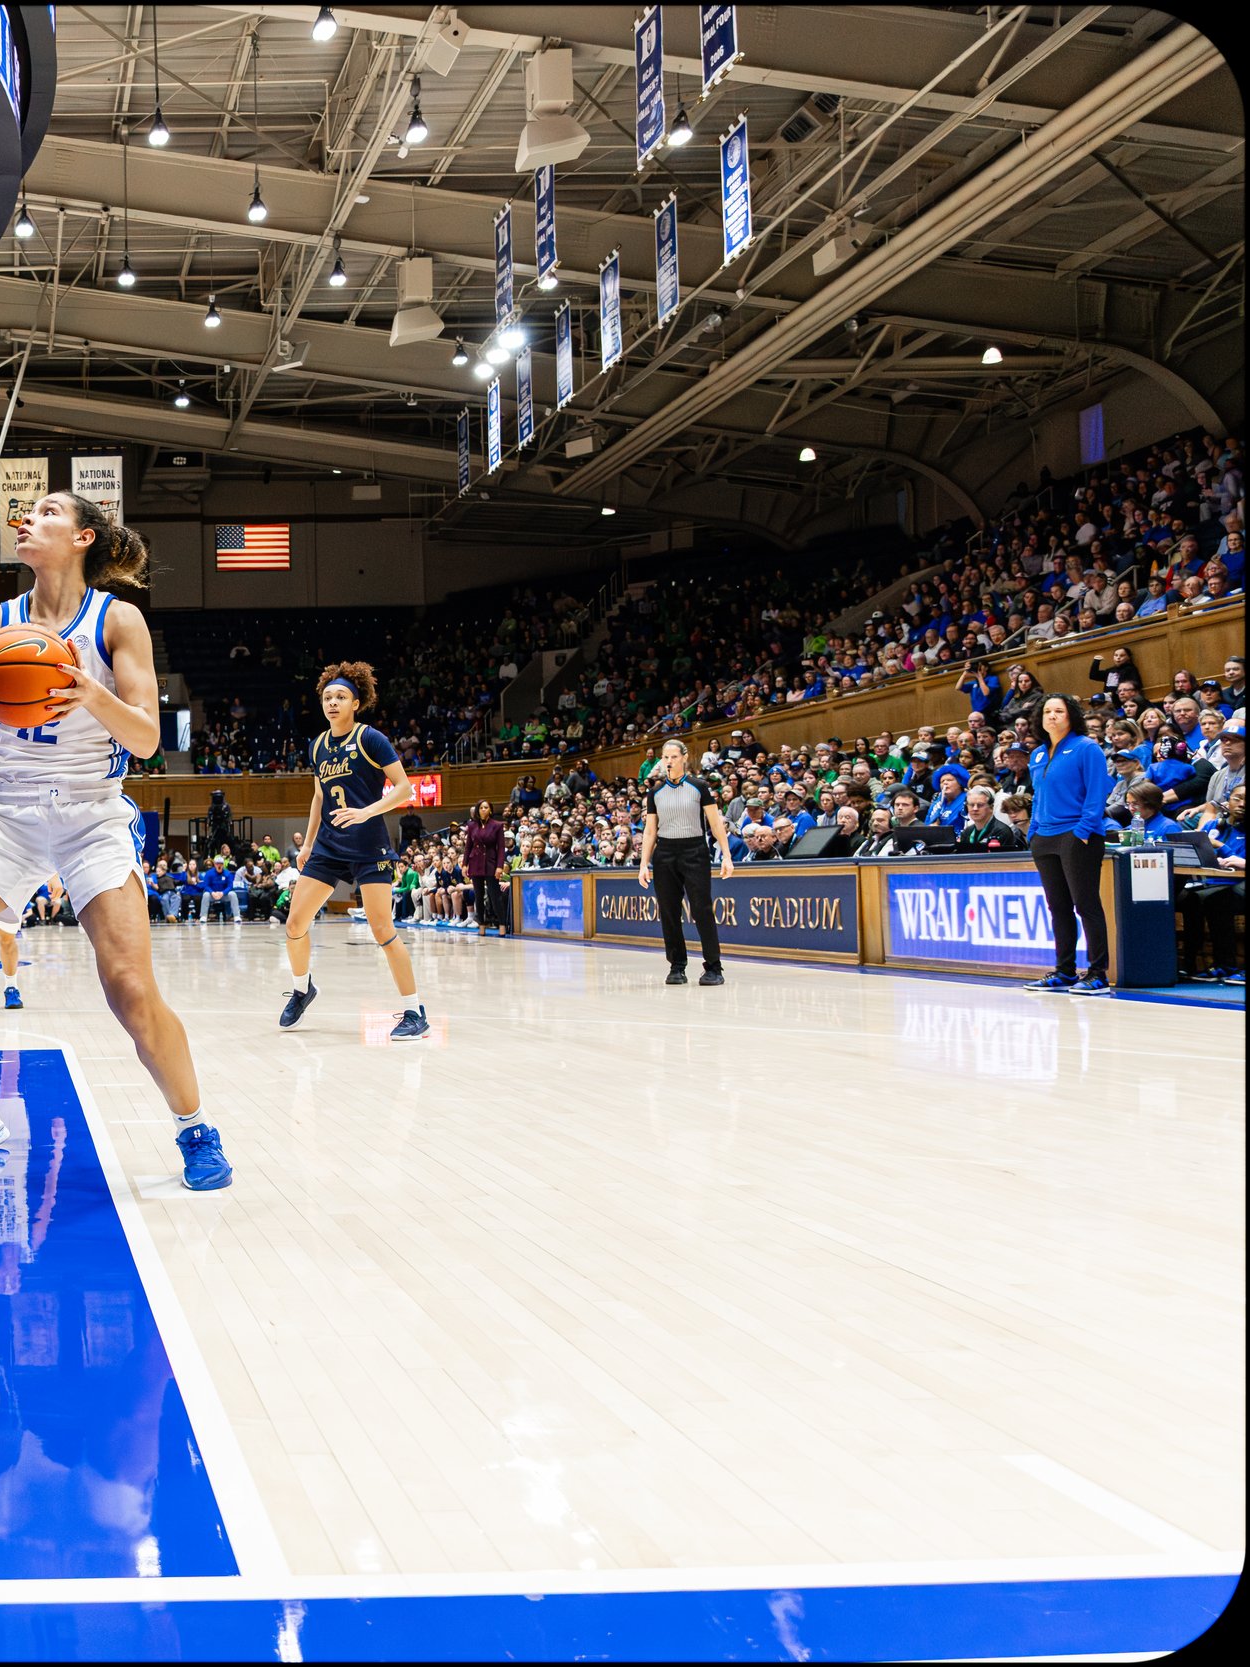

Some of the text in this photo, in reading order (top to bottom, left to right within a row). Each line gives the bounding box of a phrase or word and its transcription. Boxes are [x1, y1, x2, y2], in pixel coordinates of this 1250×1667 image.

[6, 471, 42, 480] NATIONAL
[80, 470, 115, 479] NATIONAL
[2, 482, 46, 492] CHAMPIONS
[76, 481, 121, 491] CHAMPIONS
[319, 757, 352, 779] Irish
[330, 785, 348, 809] 3
[750, 897, 843, 931] STADIUM
[894, 888, 1080, 942] WRAL NEW
